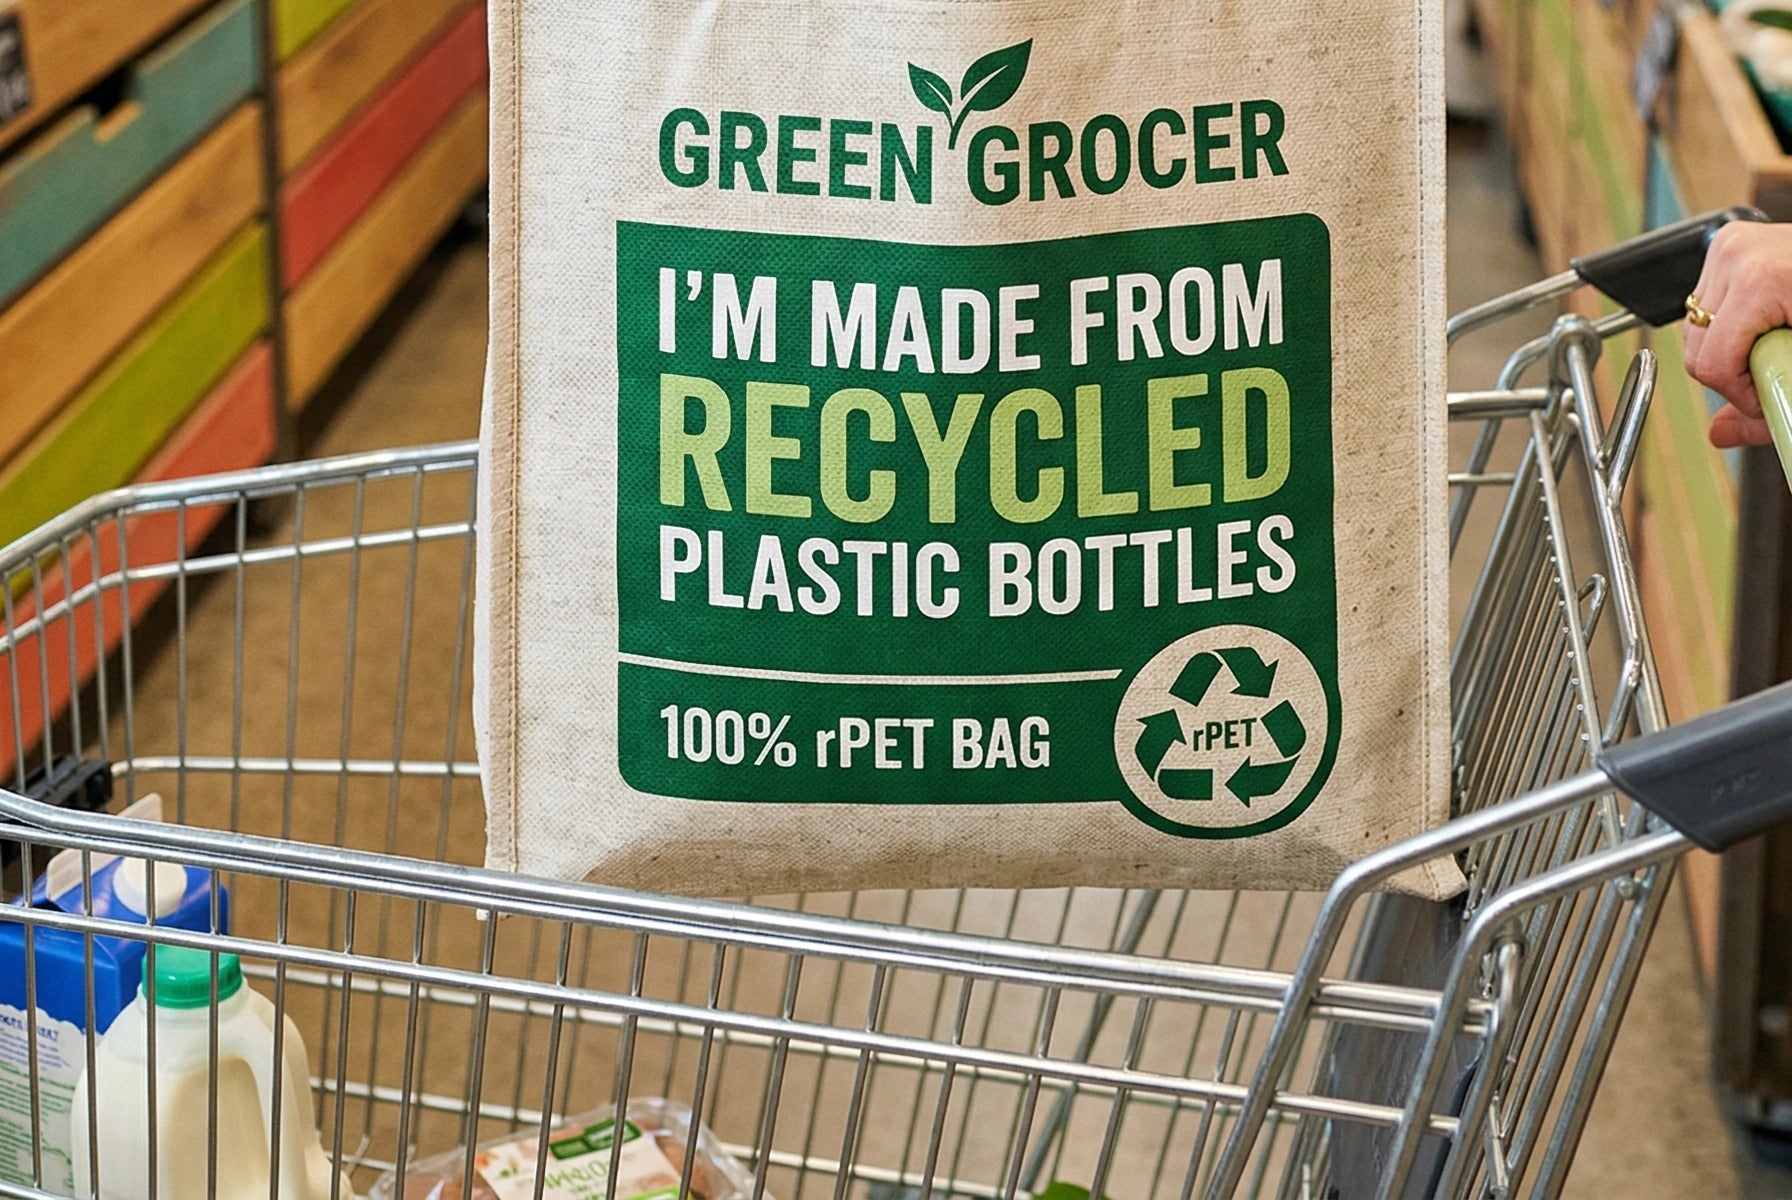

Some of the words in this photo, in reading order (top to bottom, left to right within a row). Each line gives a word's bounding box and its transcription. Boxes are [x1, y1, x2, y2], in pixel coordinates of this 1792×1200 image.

[658, 107, 933, 205] GREEN
[967, 99, 1290, 206] GROCER
[659, 266, 777, 363] I’M
[811, 280, 1041, 375] MADE
[1070, 258, 1284, 367] FROM
[659, 367, 1291, 524] RECYCLED
[659, 524, 960, 619] PLASTIC
[988, 514, 1297, 617] BOTTLES
[660, 704, 798, 768] 100%
[816, 717, 935, 769] rPET
[952, 716, 1051, 769] BAG
[1193, 717, 1258, 752] rPET
